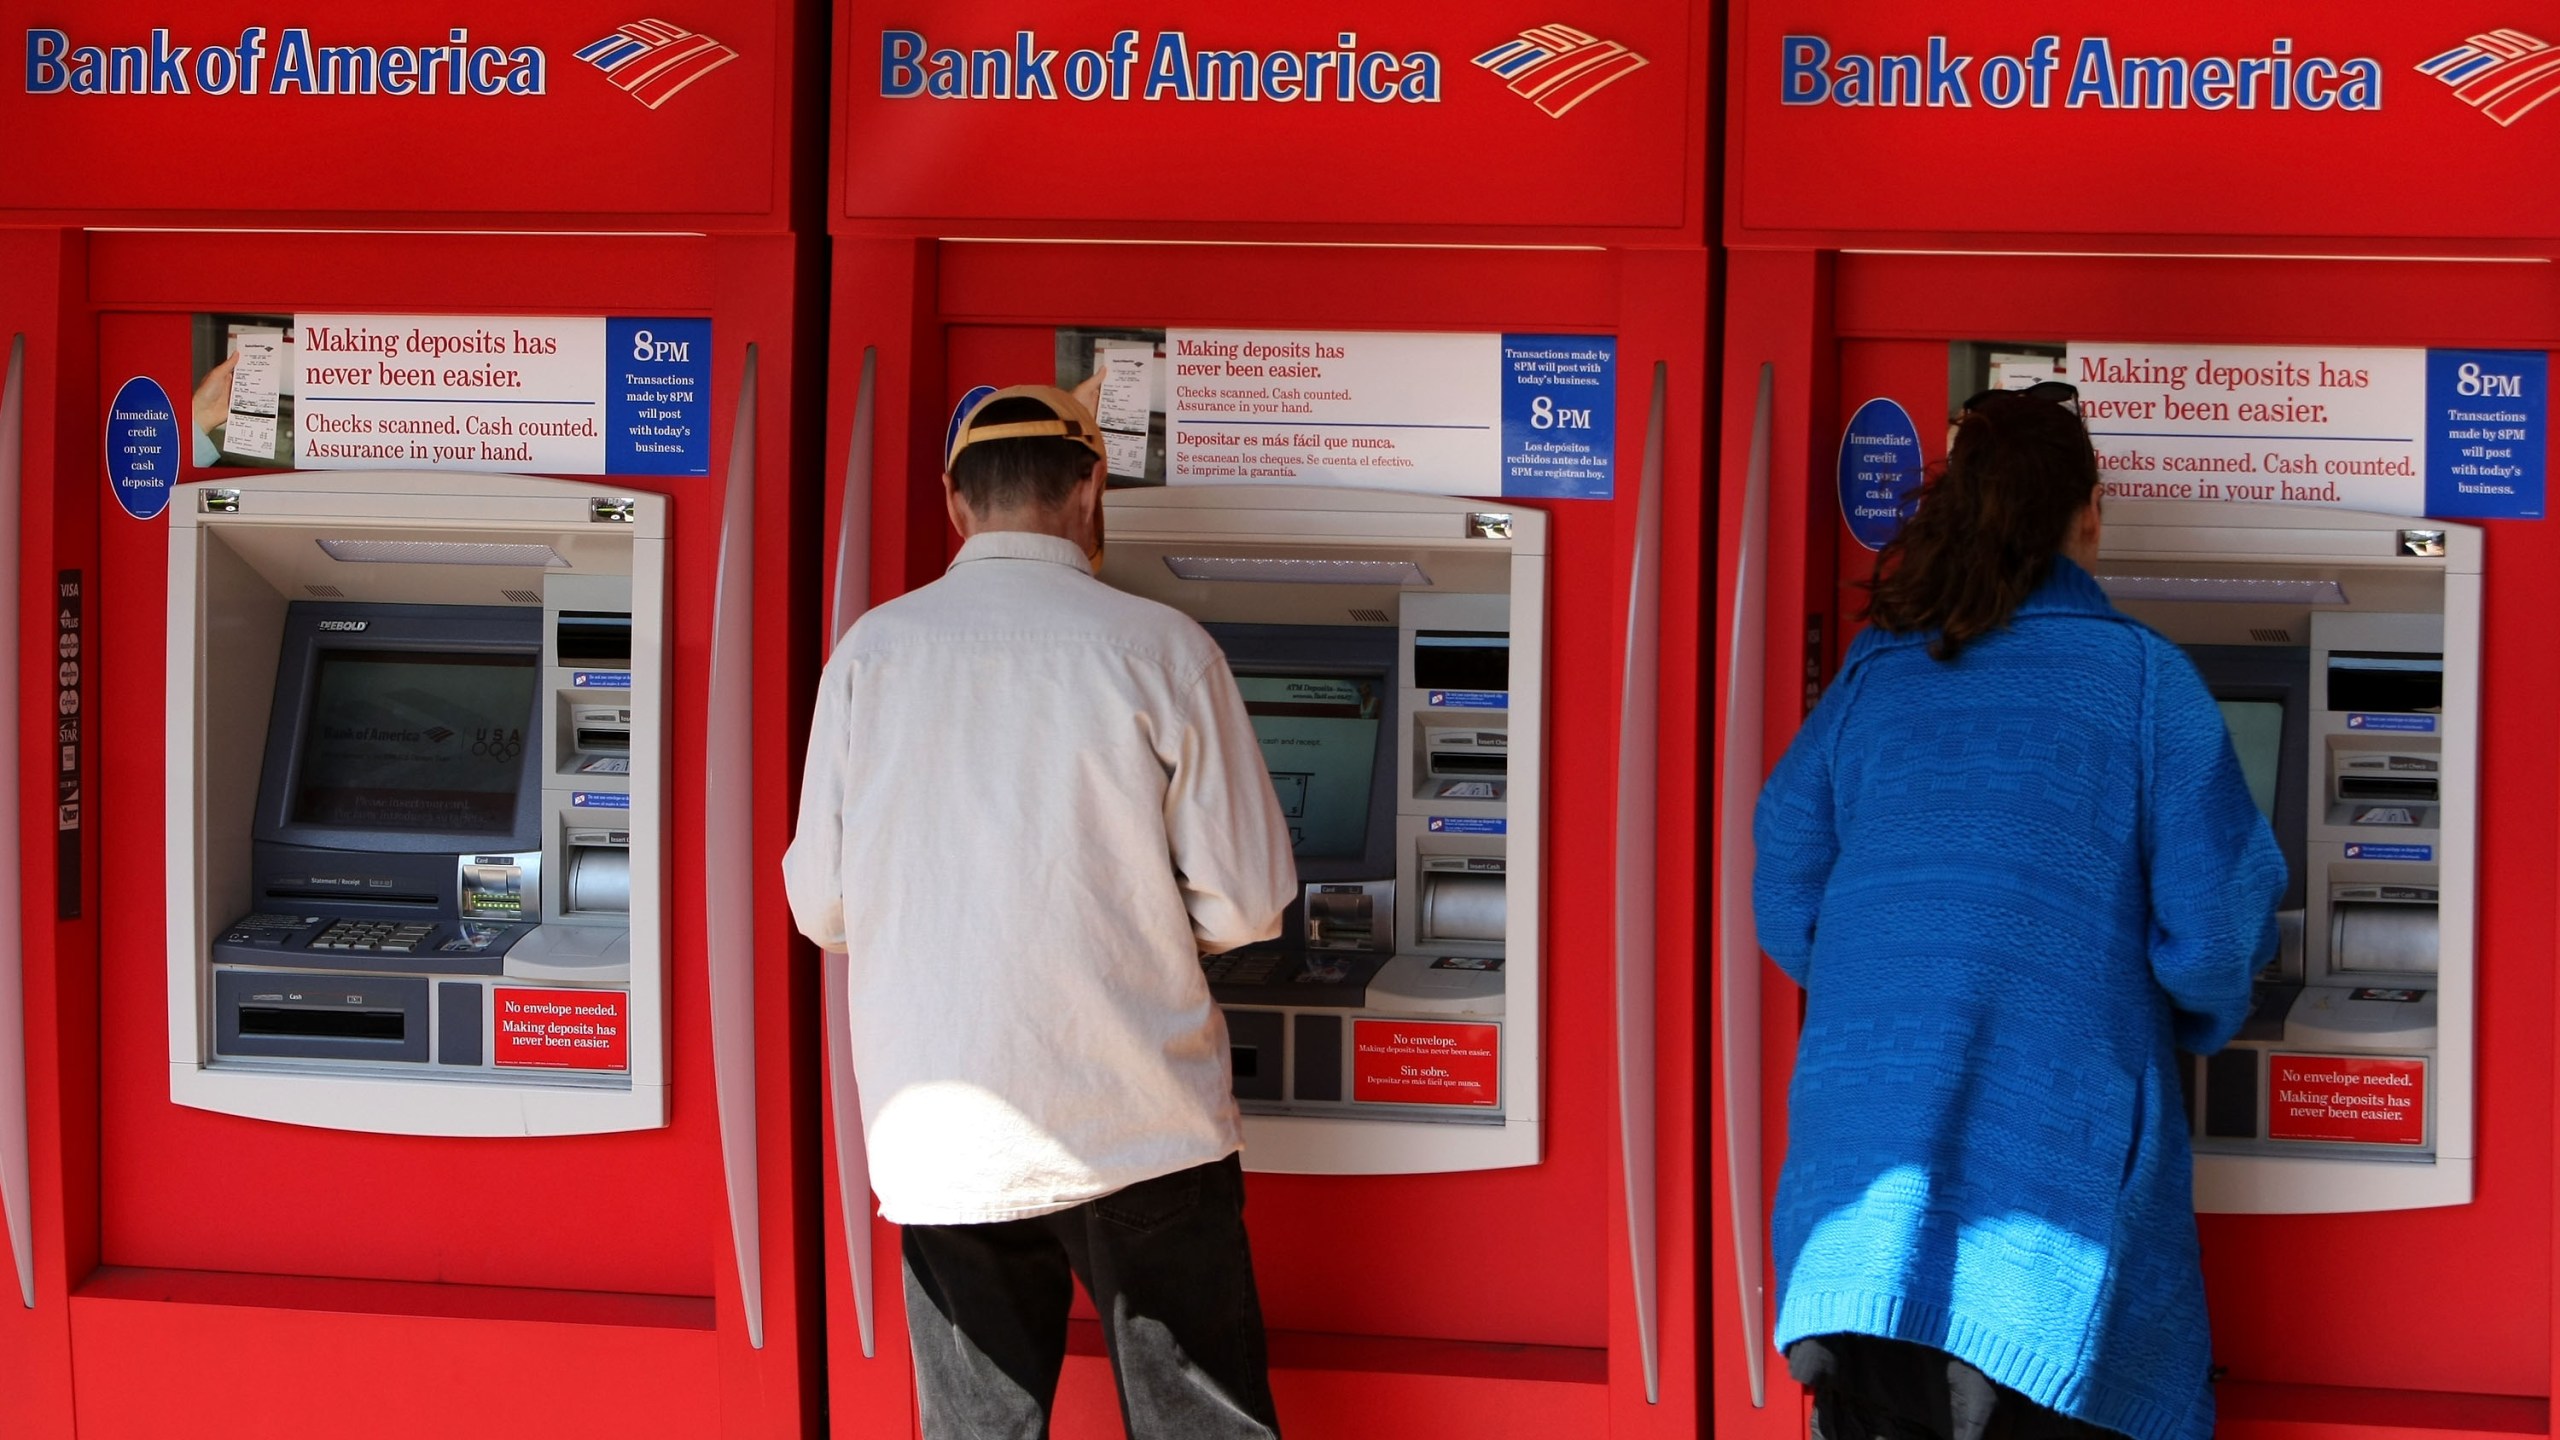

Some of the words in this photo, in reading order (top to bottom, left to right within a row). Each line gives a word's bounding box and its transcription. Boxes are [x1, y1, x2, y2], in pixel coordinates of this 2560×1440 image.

[25, 28, 191, 95] Bank
[195, 27, 267, 94] of
[269, 28, 546, 95] America
[880, 30, 1057, 99] Bank
[1065, 30, 1140, 99] of
[1143, 31, 1441, 102] America
[1781, 35, 1970, 107] Bank
[1979, 35, 2059, 108] of
[2066, 37, 2381, 111] America
[306, 328, 399, 358] Making
[406, 329, 505, 358] deposits
[513, 330, 556, 354] has
[634, 331, 689, 362] 8PM
[1177, 340, 1238, 361] Making
[1243, 341, 1310, 361] deposits
[1316, 343, 1344, 358] has
[1505, 349, 1569, 359] Transactions
[1571, 350, 1597, 360] made
[1599, 351, 1610, 362] by
[306, 368, 372, 385] never
[378, 362, 436, 386] been
[444, 363, 520, 387] easier.
[1177, 365, 1221, 376] never
[1226, 359, 1266, 376] been
[1269, 362, 1321, 377] easier.
[1514, 362, 1536, 371] 8PM
[1538, 363, 1555, 372] will
[1557, 364, 1578, 374] post
[1579, 363, 1601, 372] with
[2080, 357, 2188, 390] Making
[2196, 359, 2309, 391] deposits
[2319, 362, 2368, 387] has
[626, 374, 694, 385] Transactions
[1518, 375, 1552, 386] today's
[1553, 375, 1599, 385] business.
[2457, 363, 2521, 397] 8PM
[627, 391, 654, 401] made
[657, 392, 668, 403] by
[670, 392, 693, 402] 8PM
[1177, 386, 1216, 398] Checks
[1220, 388, 1269, 399] scanned.
[1273, 388, 1300, 399] Cash
[1304, 390, 1351, 400] counted.
[1177, 400, 1235, 411] Assurance
[1240, 401, 1250, 412] in
[1253, 404, 1278, 414] your
[1282, 402, 1312, 413] hand.
[2081, 400, 2156, 420] never
[2163, 395, 2229, 421] been
[2238, 397, 2327, 422] easier.
[116, 410, 168, 420] Immediate
[639, 408, 657, 418] will
[659, 410, 681, 420] post
[2448, 410, 2526, 422] Transactions
[306, 413, 372, 433] Checks
[379, 416, 459, 434] scanned.
[466, 416, 512, 435] Cash
[519, 418, 597, 436] counted.
[629, 425, 652, 435] with
[654, 426, 690, 437] today's
[128, 427, 157, 437] credit
[2449, 428, 2480, 439] made
[2483, 429, 2496, 441] by
[2498, 429, 2525, 440] 8PM
[1177, 432, 1240, 447] Depositar
[1244, 437, 1257, 446] es
[1262, 434, 1289, 446] más
[1294, 434, 1320, 447] fácil
[1325, 438, 1347, 449] que
[1353, 439, 1394, 449] nunca.
[1850, 433, 1911, 446] Immediate
[139, 446, 161, 455] your
[306, 439, 403, 458] Assurance
[410, 440, 428, 459] in
[433, 447, 475, 463] your
[481, 441, 532, 461] hand.
[636, 442, 684, 452] business.
[1525, 442, 1542, 451] Los
[1543, 442, 1590, 453] depósitos
[2462, 446, 2483, 457] will
[2486, 449, 2511, 459] post
[1177, 452, 1189, 462] Se
[1192, 455, 1239, 464] escanean
[1242, 453, 1257, 464] los
[1260, 454, 1304, 466] cheques.
[1306, 454, 1319, 464] Se
[1322, 457, 1357, 466] cuenta
[1360, 457, 1369, 466] el
[1371, 457, 1414, 467] efectivo.
[1507, 454, 1550, 464] recibidos
[1580, 456, 1591, 465] de
[1593, 457, 1607, 466] las
[1863, 452, 1897, 463] credit
[2096, 450, 2155, 471] hecks
[2162, 453, 2256, 473] scanned.
[2264, 453, 2317, 474] Cash
[2325, 456, 2416, 476] counted.
[132, 460, 154, 470] cash
[1177, 465, 1189, 474] Se
[1192, 465, 1235, 476] imprime
[1238, 466, 1248, 476] la
[1250, 466, 1297, 478] garantía.
[2451, 464, 2478, 475] with
[2480, 465, 2521, 478] today's
[1511, 467, 1532, 476] 8PM
[1545, 468, 1585, 478] registran
[1587, 469, 1605, 480] hoy.
[123, 477, 164, 489] deposits
[2458, 482, 2514, 494] business.
[2100, 482, 2191, 498] ssurance
[2198, 479, 2219, 499] in
[2225, 484, 2274, 502] your
[2281, 481, 2341, 501] hand.
[60, 583, 79, 597] VISA
[65, 618, 79, 628] PLUS
[319, 621, 366, 631] DIEBOLD
[59, 729, 78, 741] STAR
[505, 1001, 520, 1012] No
[524, 1003, 571, 1016] envelope
[575, 1004, 617, 1016] needed.
[503, 1020, 545, 1034] Making
[548, 1022, 593, 1035] deposits
[597, 1024, 616, 1035] has
[512, 1036, 543, 1046] never
[545, 1035, 571, 1046] been
[574, 1037, 609, 1048] easier.
[1394, 1034, 1408, 1044] No
[1410, 1036, 1457, 1047] envelope.
[1360, 1045, 1385, 1053] Making
[1386, 1046, 1415, 1054] deposits
[1401, 1065, 1417, 1076] Sin
[1420, 1066, 1449, 1077] sobre.
[2283, 1069, 2300, 1081] No
[2304, 1072, 2359, 1086] envelope
[2363, 1073, 2412, 1086] needed.
[2280, 1090, 2328, 1105] Making
[2331, 1093, 2384, 1107] deposits
[2388, 1095, 2410, 1107] has
[2290, 1107, 2325, 1117] never
[2328, 1106, 2357, 1119] been
[2362, 1108, 2402, 1120] easier.
